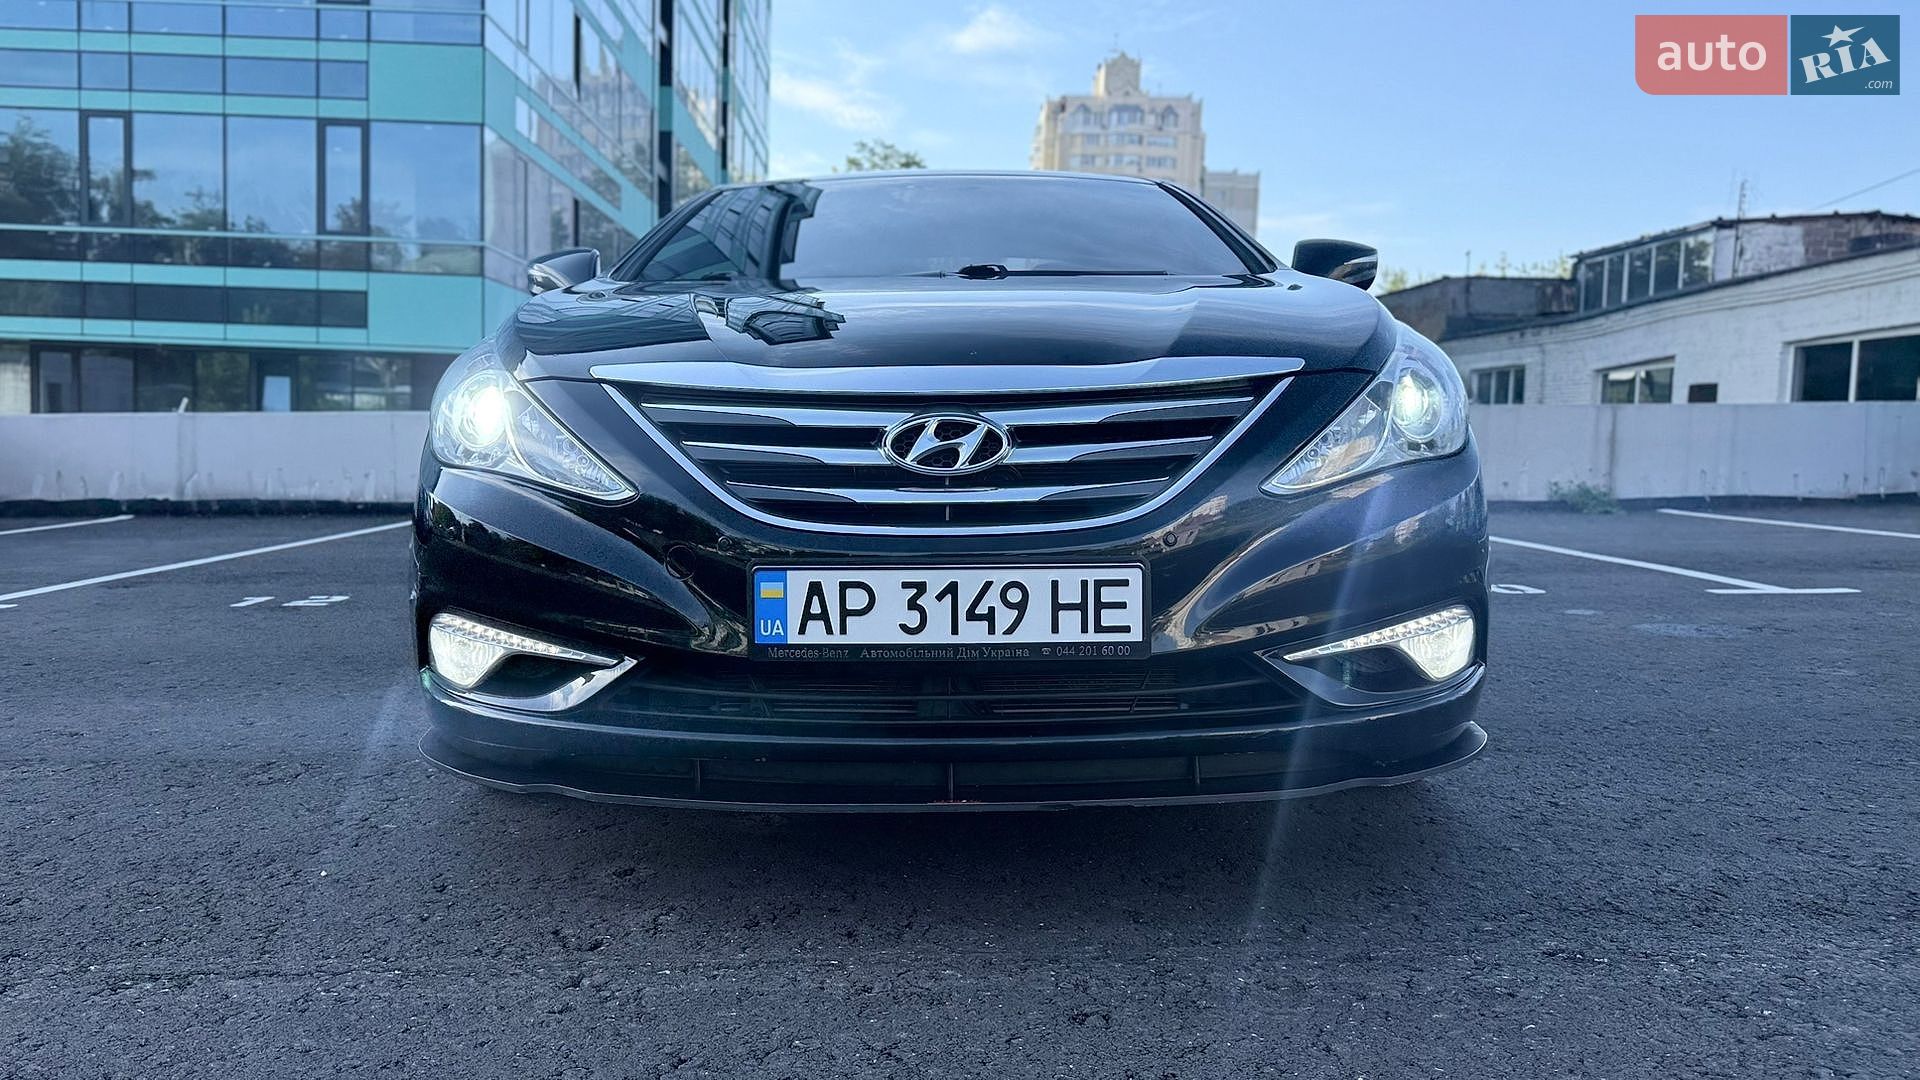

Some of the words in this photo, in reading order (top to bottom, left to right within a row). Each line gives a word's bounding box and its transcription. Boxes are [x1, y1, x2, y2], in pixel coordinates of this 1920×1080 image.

[798, 580, 876, 635] AP
[898, 580, 1030, 635] 3149
[1050, 579, 1131, 634] HE
[760, 619, 785, 636] UA
[767, 647, 849, 659] Mercedes-Benz
[1056, 645, 1076, 657] 044
[1078, 645, 1098, 656] 201
[1101, 645, 1115, 656] 60
[1117, 645, 1131, 656] 00
